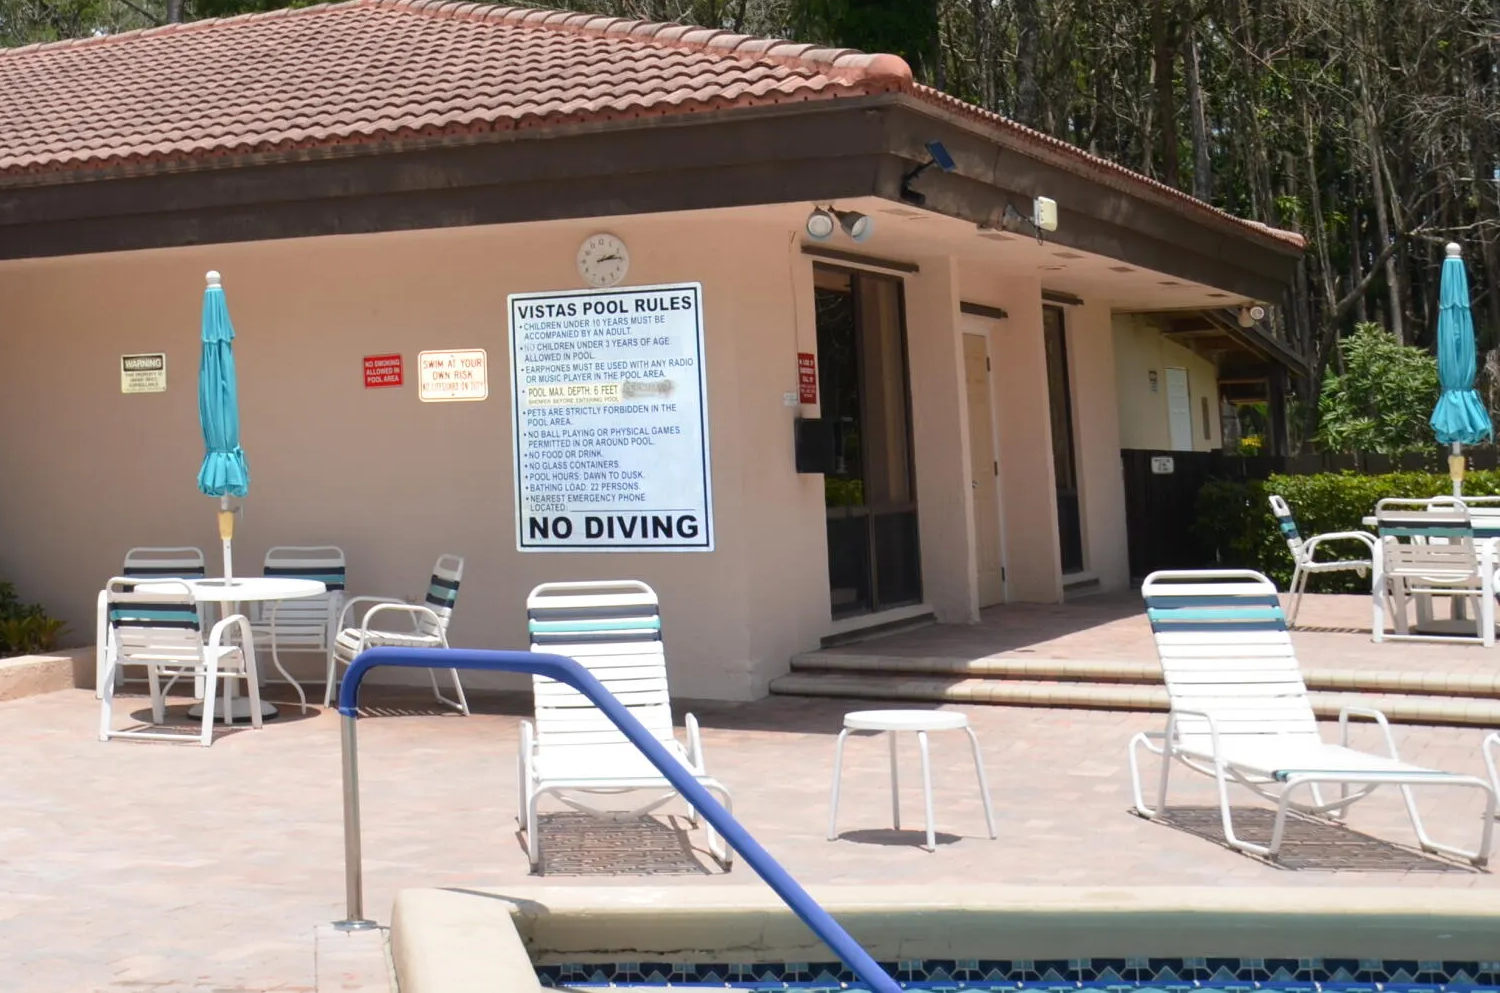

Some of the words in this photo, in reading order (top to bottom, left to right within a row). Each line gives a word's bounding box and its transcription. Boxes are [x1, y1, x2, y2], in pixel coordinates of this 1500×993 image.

[518, 303, 576, 319] VISTAS
[583, 300, 628, 315] POOL
[635, 296, 692, 312] RULES
[524, 322, 561, 331] CHILDREN
[564, 319, 589, 328] UNDER
[603, 318, 628, 326] YEARS
[631, 316, 651, 324] MUST
[524, 330, 579, 340] ACCOMPANIED
[582, 329, 591, 337] BY
[593, 328, 603, 336] AN
[537, 342, 574, 351] CHILDREN
[577, 340, 603, 349] UNDER
[612, 338, 638, 347] YEARS
[125, 358, 162, 368] WARNING
[525, 354, 561, 363] ALLOWED
[573, 352, 596, 360] POOL.
[423, 360, 443, 369] SWIM
[461, 358, 482, 367] YOUR
[526, 365, 571, 374] EARPHONES
[572, 363, 594, 372] MUST
[596, 362, 605, 370] BE
[607, 361, 628, 370] USED
[630, 360, 649, 368] WITH
[651, 359, 667, 368] ANY
[669, 358, 693, 367] RADIO
[454, 371, 473, 379] RISK
[539, 374, 562, 383] MUSIC
[564, 373, 592, 382] PLAYER
[604, 371, 618, 379] THE
[620, 370, 641, 379] POOL
[643, 369, 666, 378] AREA.
[529, 388, 546, 397] POOL
[594, 385, 598, 394] 6
[601, 385, 618, 394] FEET
[528, 409, 547, 417] PETS
[548, 408, 563, 416] ARE
[566, 407, 601, 415] STRICTLY
[604, 405, 649, 414] FORBIDDEN
[528, 418, 548, 426] POOL
[528, 430, 539, 438] NO
[541, 429, 560, 438] BALL
[562, 428, 595, 437] PLAYING
[597, 428, 609, 436] OR
[611, 427, 649, 436] PHYSICAL
[652, 426, 680, 434] GAMES
[528, 439, 570, 448] PERMITTED
[583, 438, 594, 446] OR
[596, 437, 629, 446] AROUND
[542, 450, 563, 459] FOOD
[566, 450, 577, 458] OR
[579, 449, 604, 458] DRINK.
[529, 462, 540, 470] NO
[542, 461, 568, 469] GLASS
[530, 473, 550, 481] POOL
[584, 471, 606, 480] DAWN
[609, 471, 619, 479] TO
[530, 484, 563, 492] BATHING
[590, 483, 599, 491] 22
[602, 482, 640, 491] PERSONS.
[531, 494, 565, 503] NEAREST
[568, 494, 617, 502] EMERGENCY
[619, 493, 645, 501] PHONE
[529, 516, 573, 539] NO
[585, 515, 699, 538] DIVING
